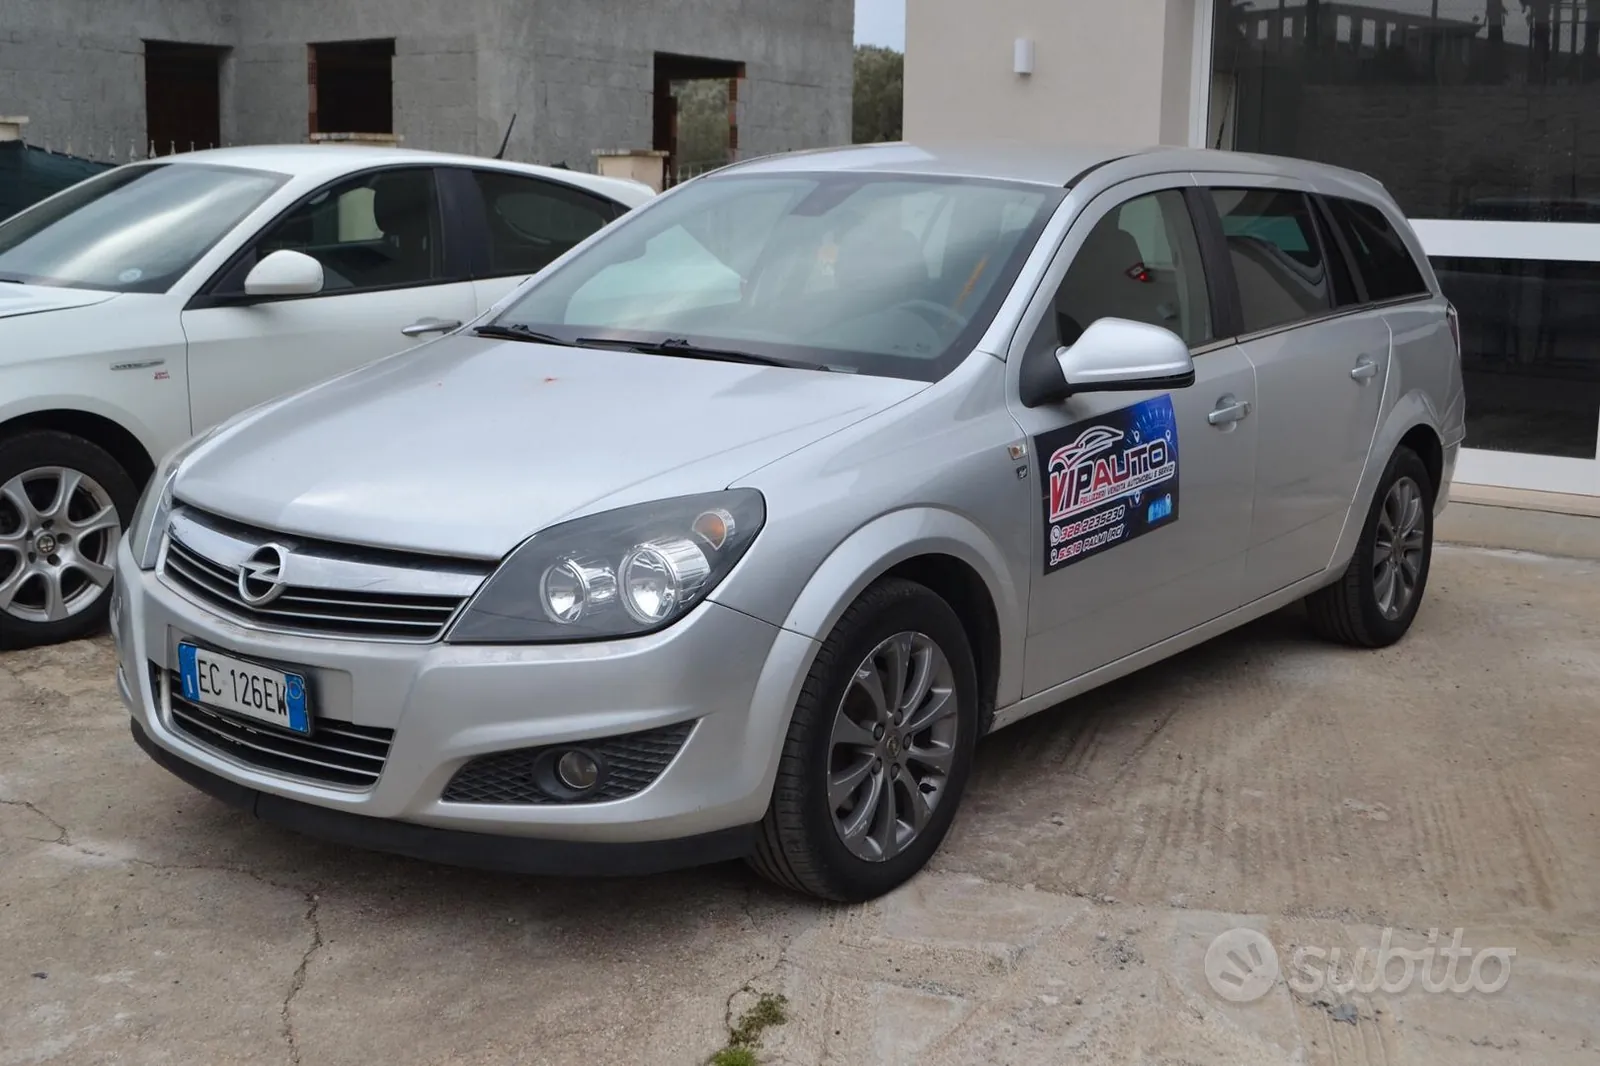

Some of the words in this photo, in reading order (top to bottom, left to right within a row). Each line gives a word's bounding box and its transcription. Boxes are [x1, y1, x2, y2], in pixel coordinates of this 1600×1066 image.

[1051, 439, 1166, 515] VIPAUTO
[1108, 483, 1126, 495] VENDITA
[198, 659, 222, 696] EC
[230, 669, 287, 716] 126EW
